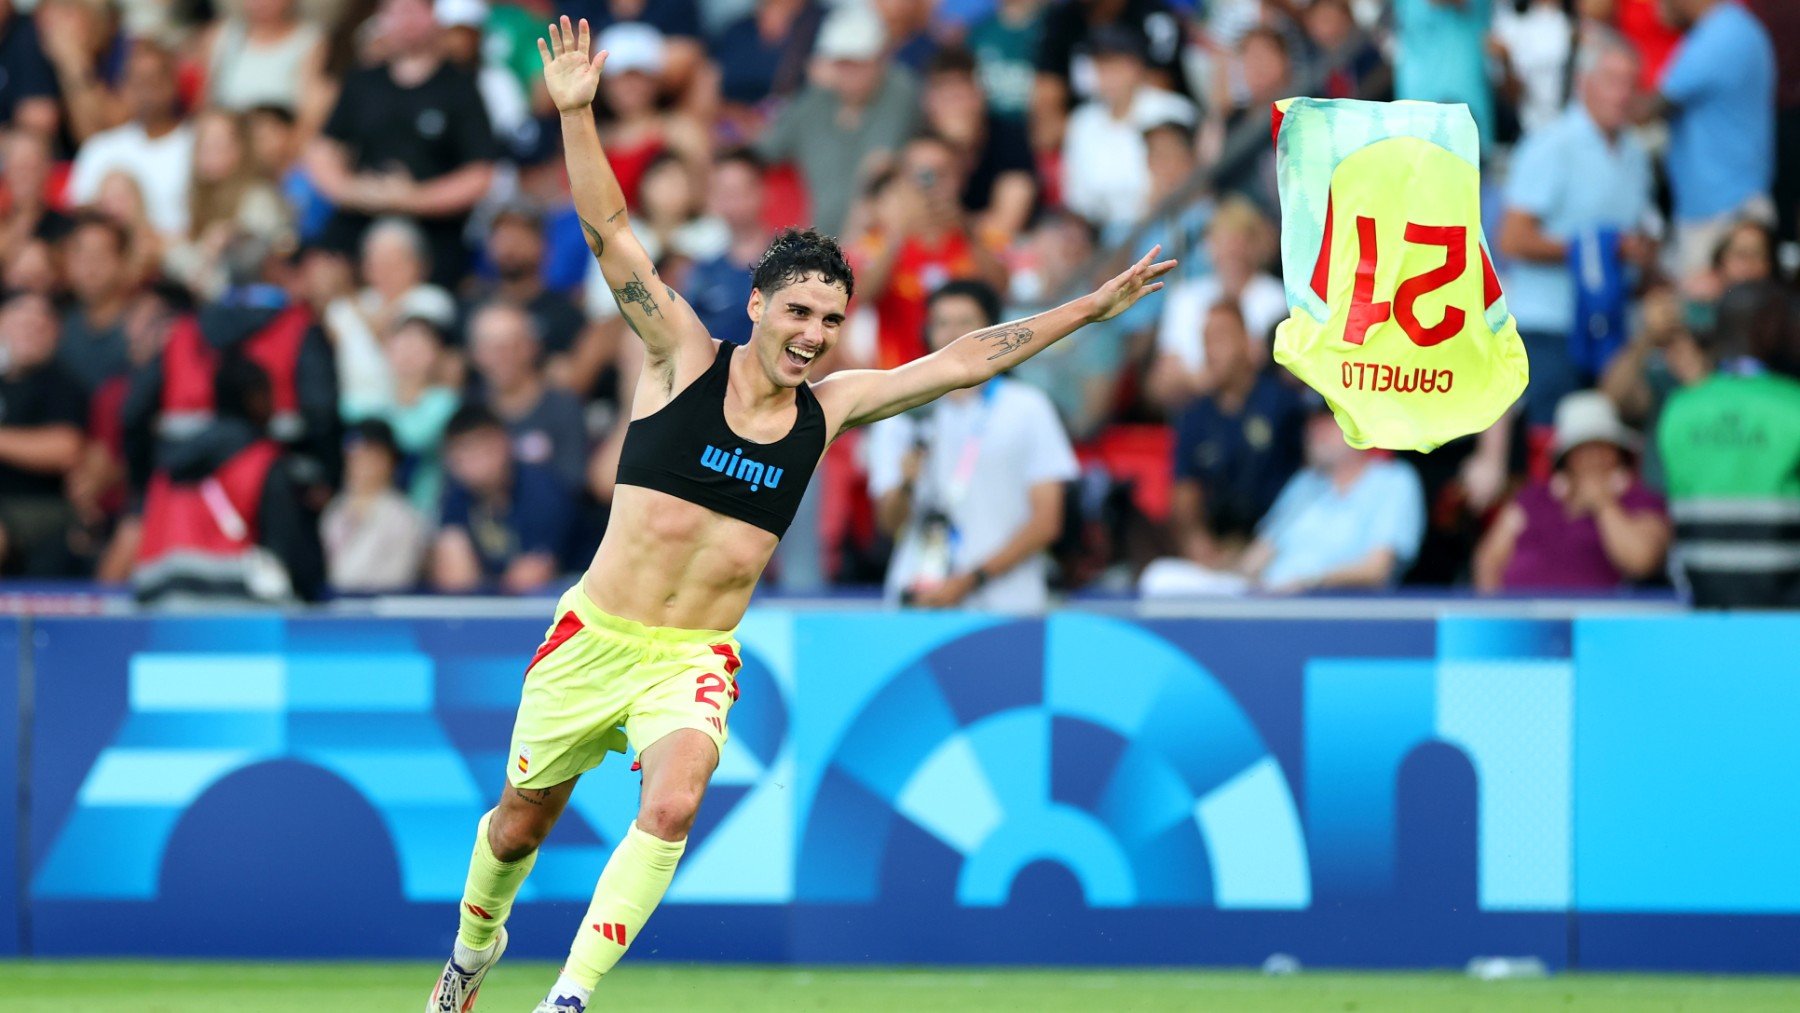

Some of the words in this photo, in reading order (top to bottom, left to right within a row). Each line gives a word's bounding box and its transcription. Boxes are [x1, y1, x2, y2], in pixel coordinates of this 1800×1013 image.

[1343, 216, 1466, 347] 21
[1342, 362, 1454, 393] CAMELLO
[700, 444, 784, 492] wimu
[694, 672, 733, 711] 2
